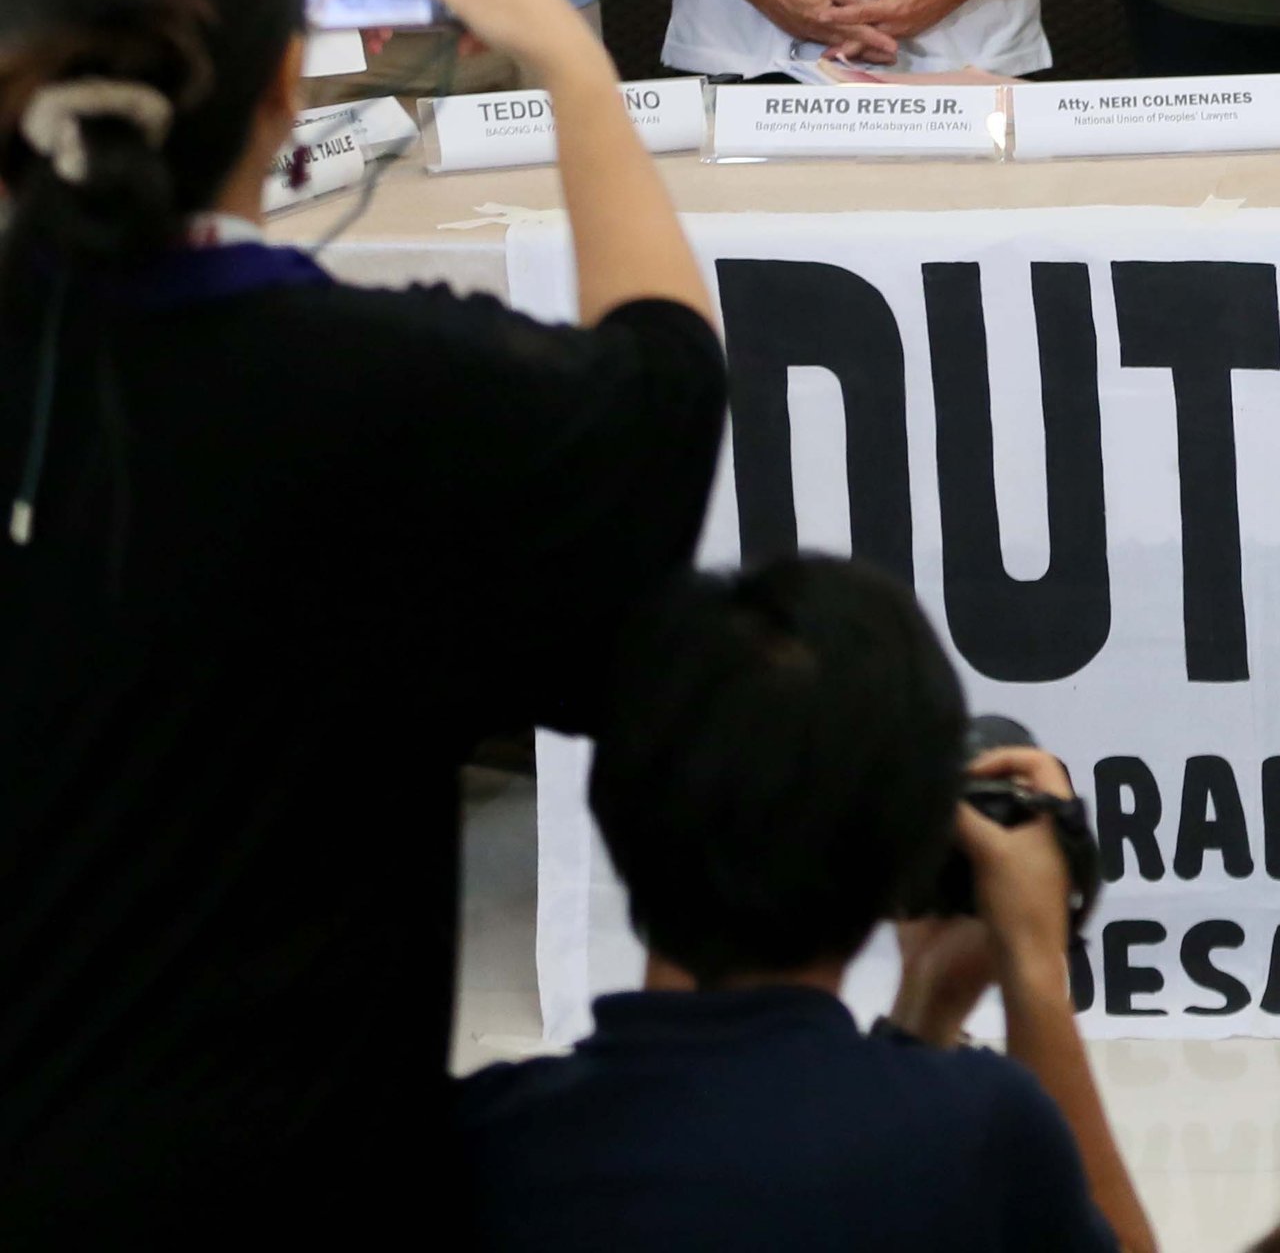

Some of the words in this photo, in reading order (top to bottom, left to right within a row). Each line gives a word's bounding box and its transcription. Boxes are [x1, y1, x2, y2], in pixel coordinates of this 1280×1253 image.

[766, 99, 850, 115] RENATO
[856, 98, 926, 114] REYES
[932, 99, 963, 115] JR.
[1058, 98, 1095, 113] Atty.
[1099, 96, 1137, 109] NERI
[1142, 92, 1253, 108] COLMENARES
[755, 121, 797, 133] Bagong
[799, 120, 856, 133] Alyansang
[859, 120, 923, 132] Makabayan
[925, 120, 972, 133] (BAYAN)
[1074, 115, 1114, 126] National
[1116, 114, 1144, 124] Union
[1146, 113, 1156, 123] of
[1200, 111, 1238, 123] Lawyers
[317, 135, 355, 159] TAULE
